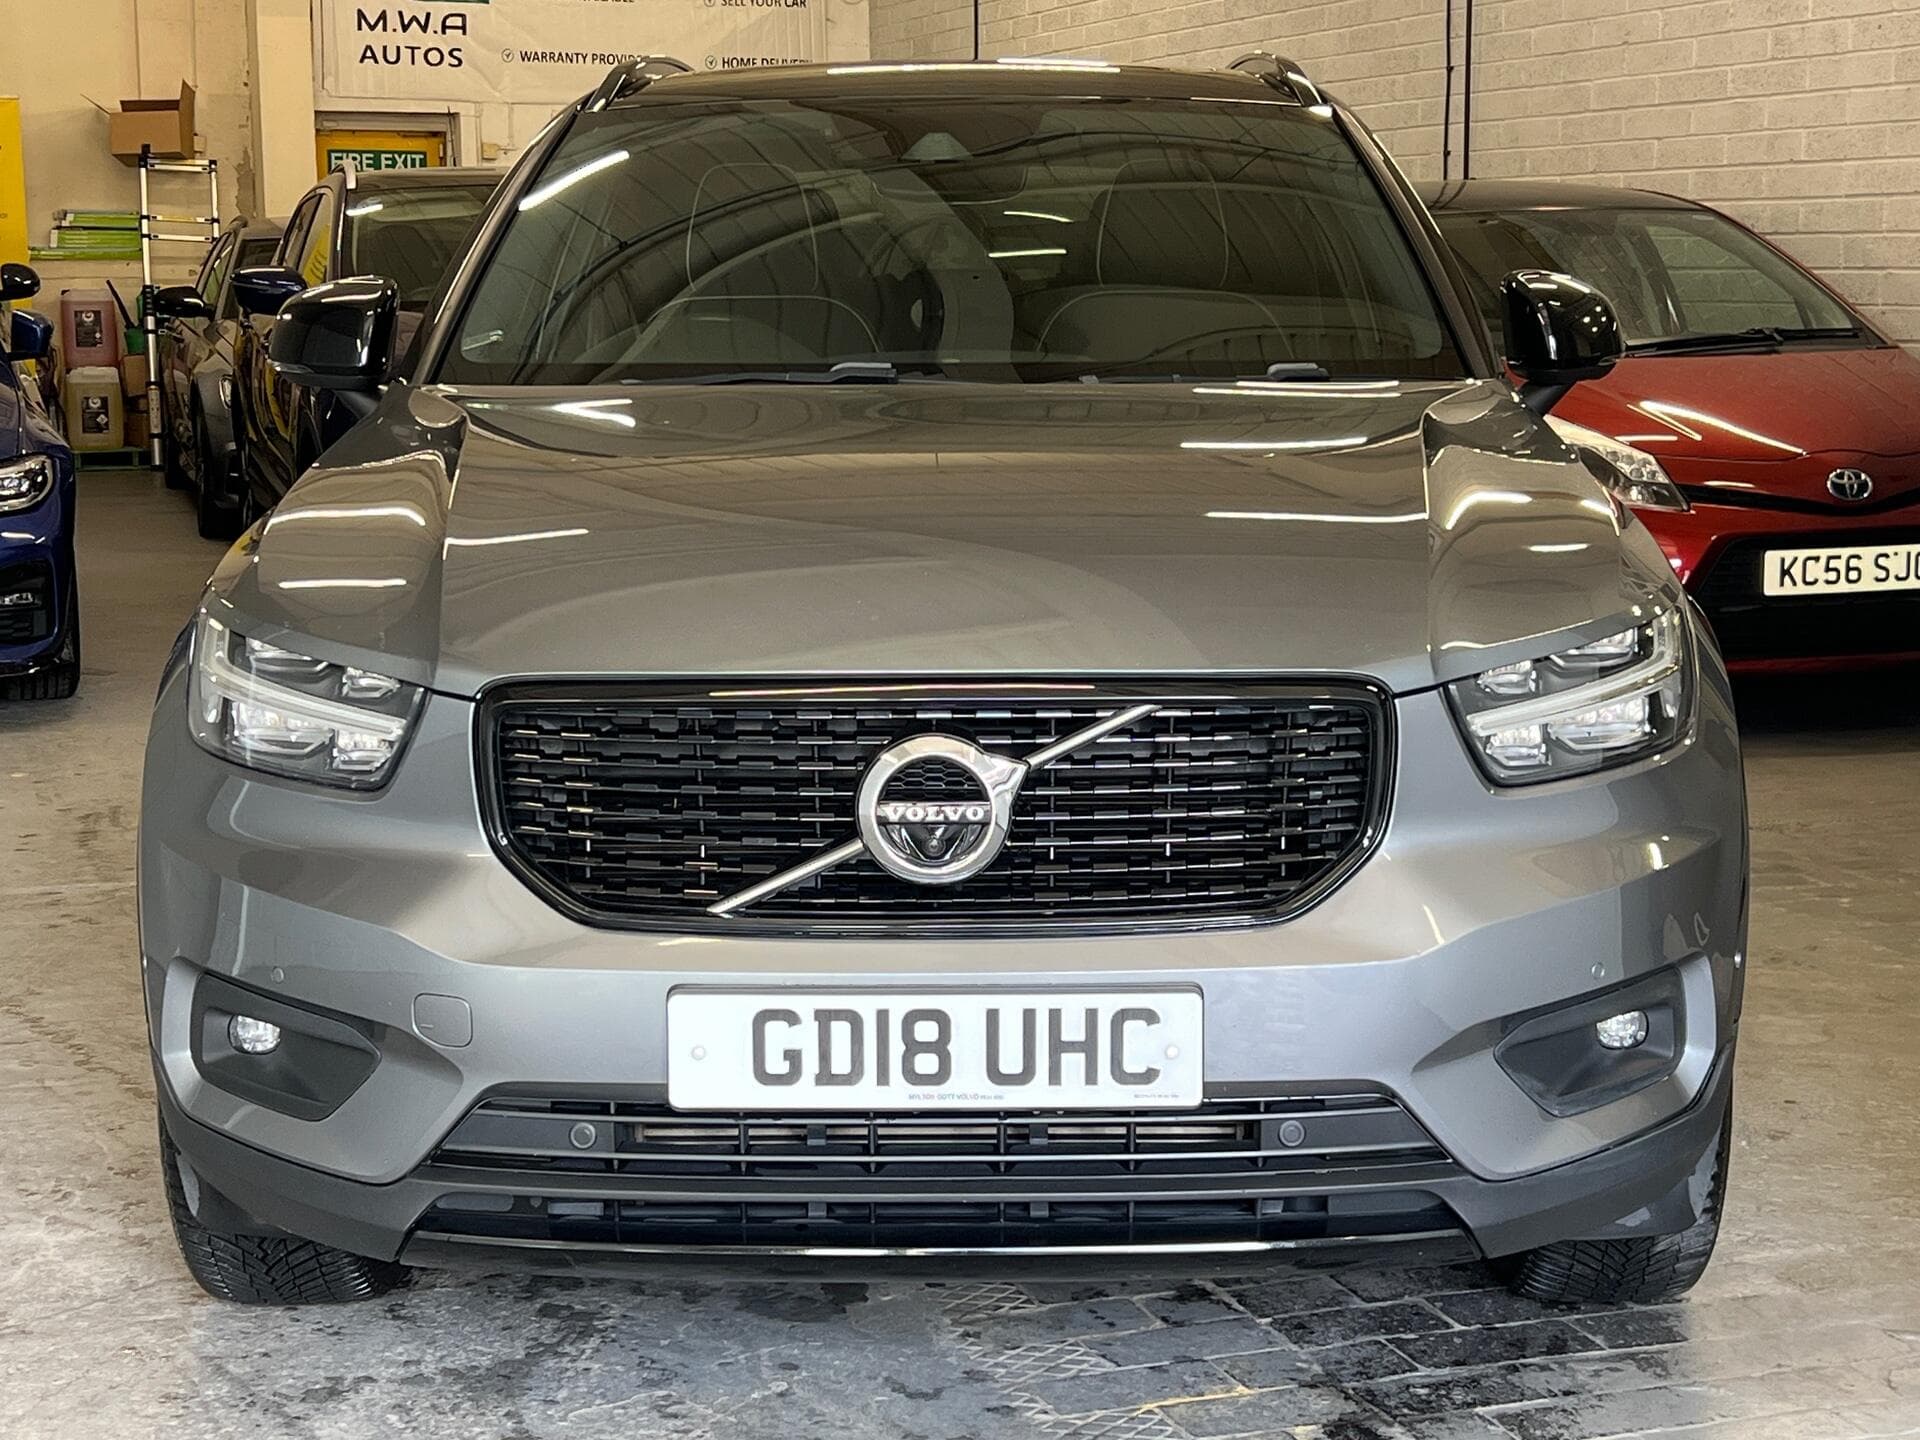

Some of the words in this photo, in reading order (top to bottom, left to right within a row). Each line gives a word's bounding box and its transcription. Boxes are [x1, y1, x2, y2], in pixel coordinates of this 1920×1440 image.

[784, 0, 807, 8] CAR
[356, 8, 467, 36] M.W.A
[359, 44, 464, 67] AUTOS
[519, 50, 588, 65] WARRANTY
[722, 57, 758, 68] HOME
[380, 153, 425, 170] EXIT
[1779, 554, 1863, 587] KC56
[884, 806, 985, 822] VOLVO
[751, 1007, 952, 1088] GD18
[985, 1007, 1162, 1088] UHC
